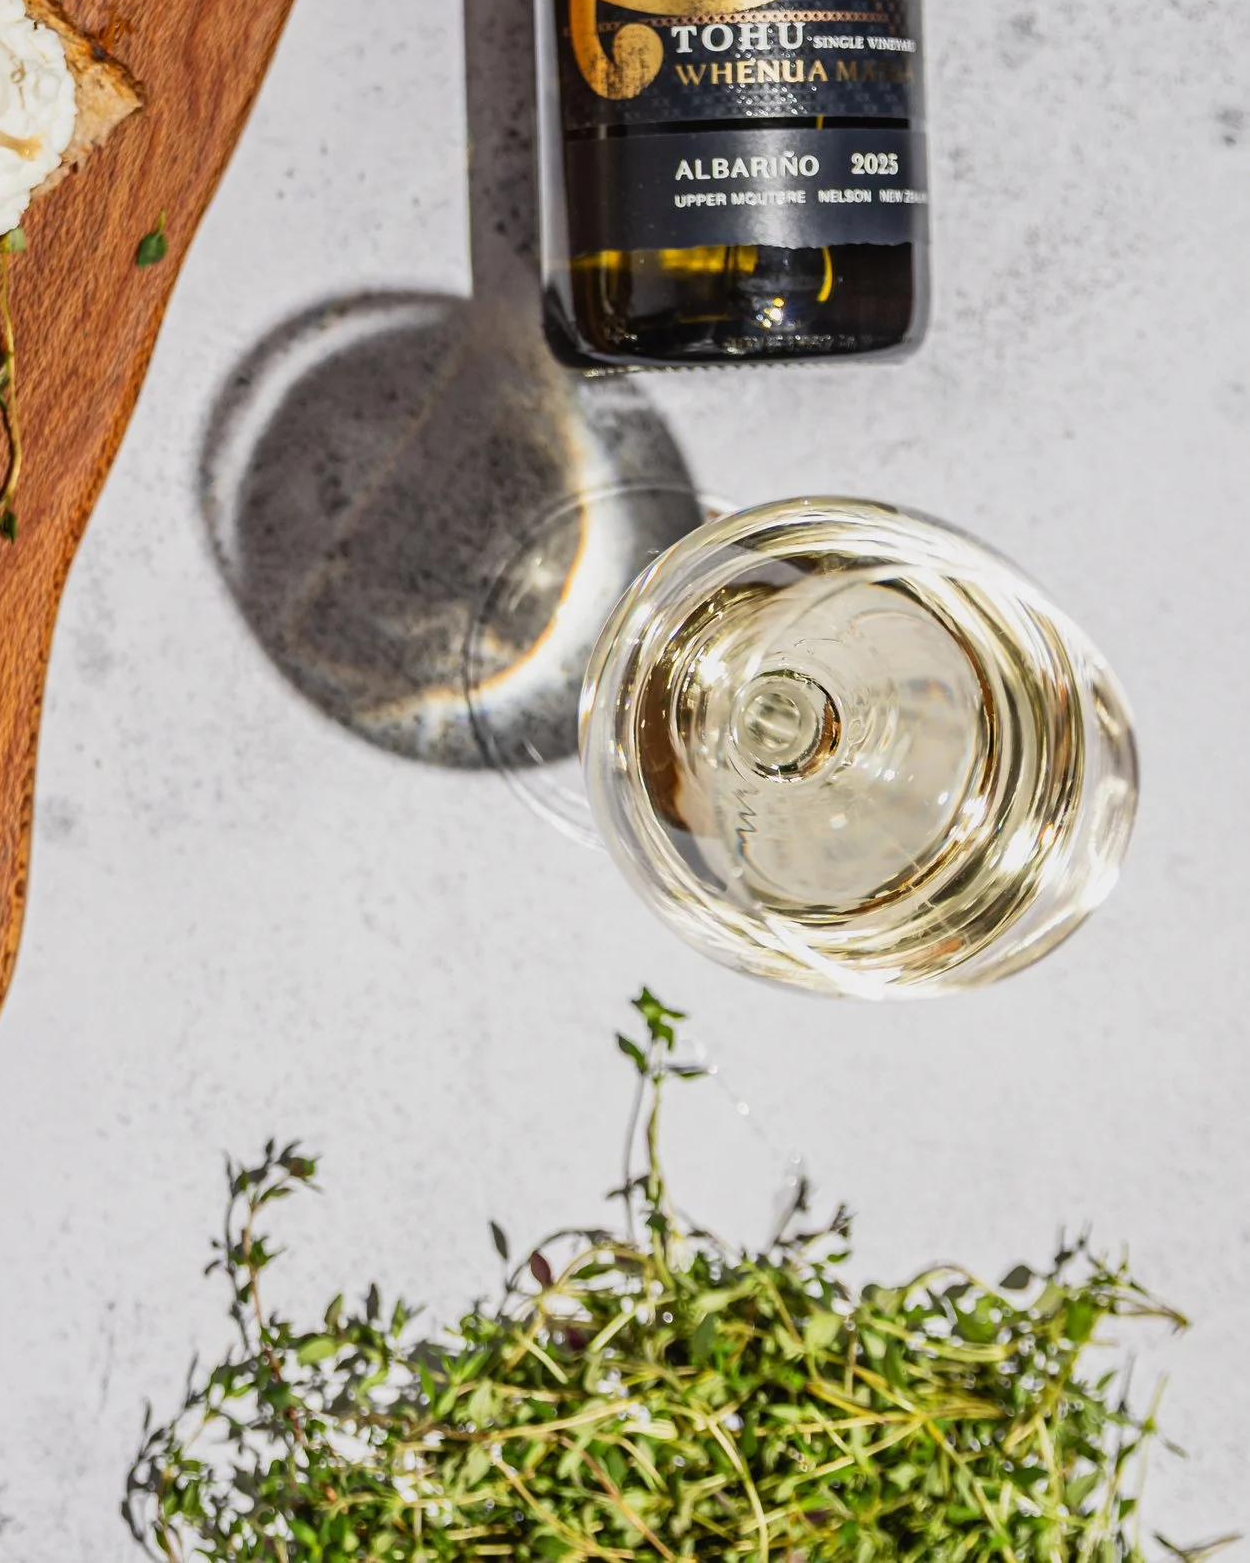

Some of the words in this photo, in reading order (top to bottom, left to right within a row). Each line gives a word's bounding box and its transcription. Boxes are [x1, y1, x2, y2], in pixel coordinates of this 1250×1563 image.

[671, 23, 806, 53] TOHU
[813, 35, 865, 49] SINGLE
[675, 59, 829, 86] WHENUA
[675, 150, 820, 181] ALBARIÑO
[851, 152, 899, 175] 2025
[674, 192, 727, 208] UPPER
[730, 190, 806, 206] MOUTERE
[817, 188, 872, 203] NELSON
[879, 189, 904, 204] NEW
